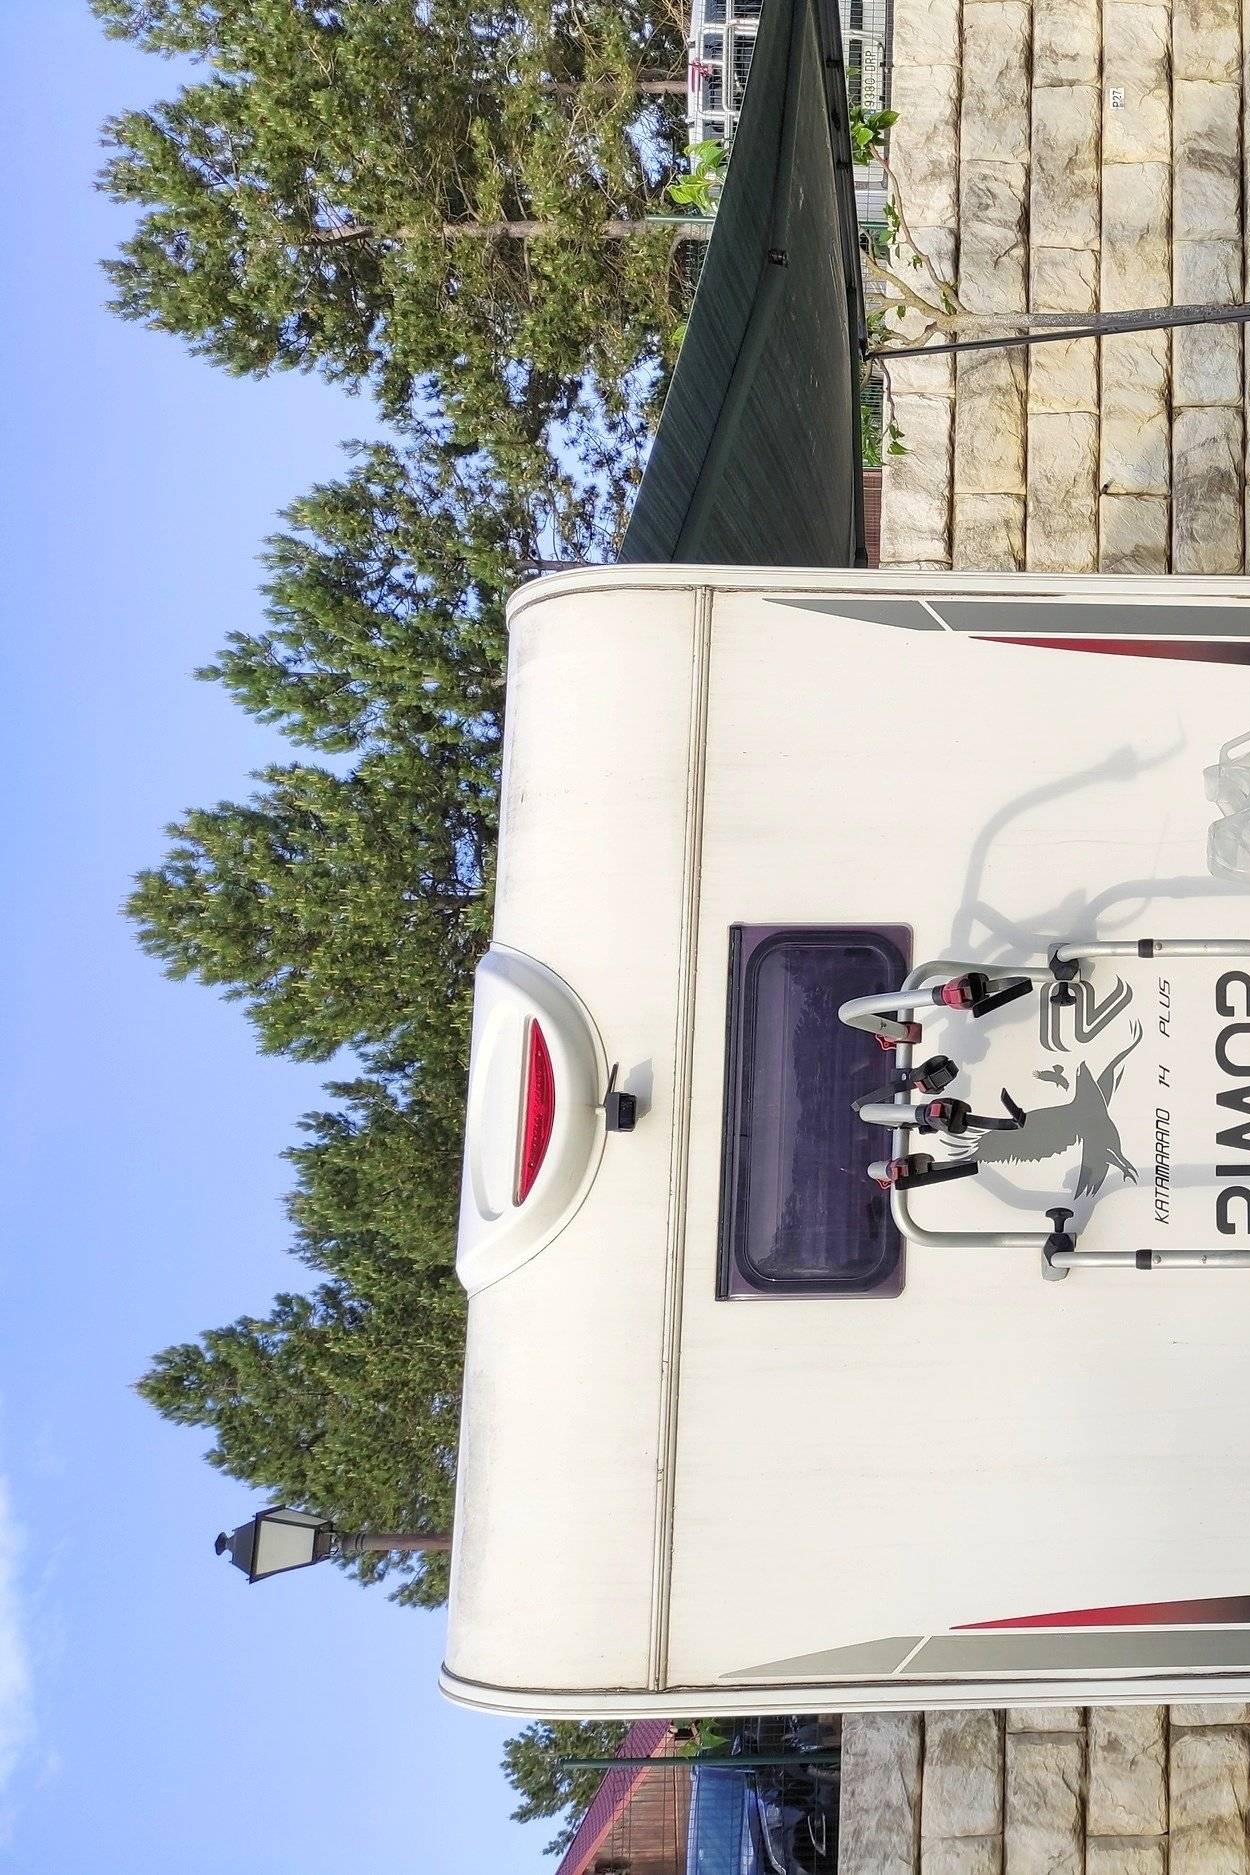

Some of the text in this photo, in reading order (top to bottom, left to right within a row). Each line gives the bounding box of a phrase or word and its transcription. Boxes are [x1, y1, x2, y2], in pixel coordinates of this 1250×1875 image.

[864, 50, 876, 107] 9380 DRP
[1154, 976, 1171, 1224] KATAMARANO 14 PLUS
